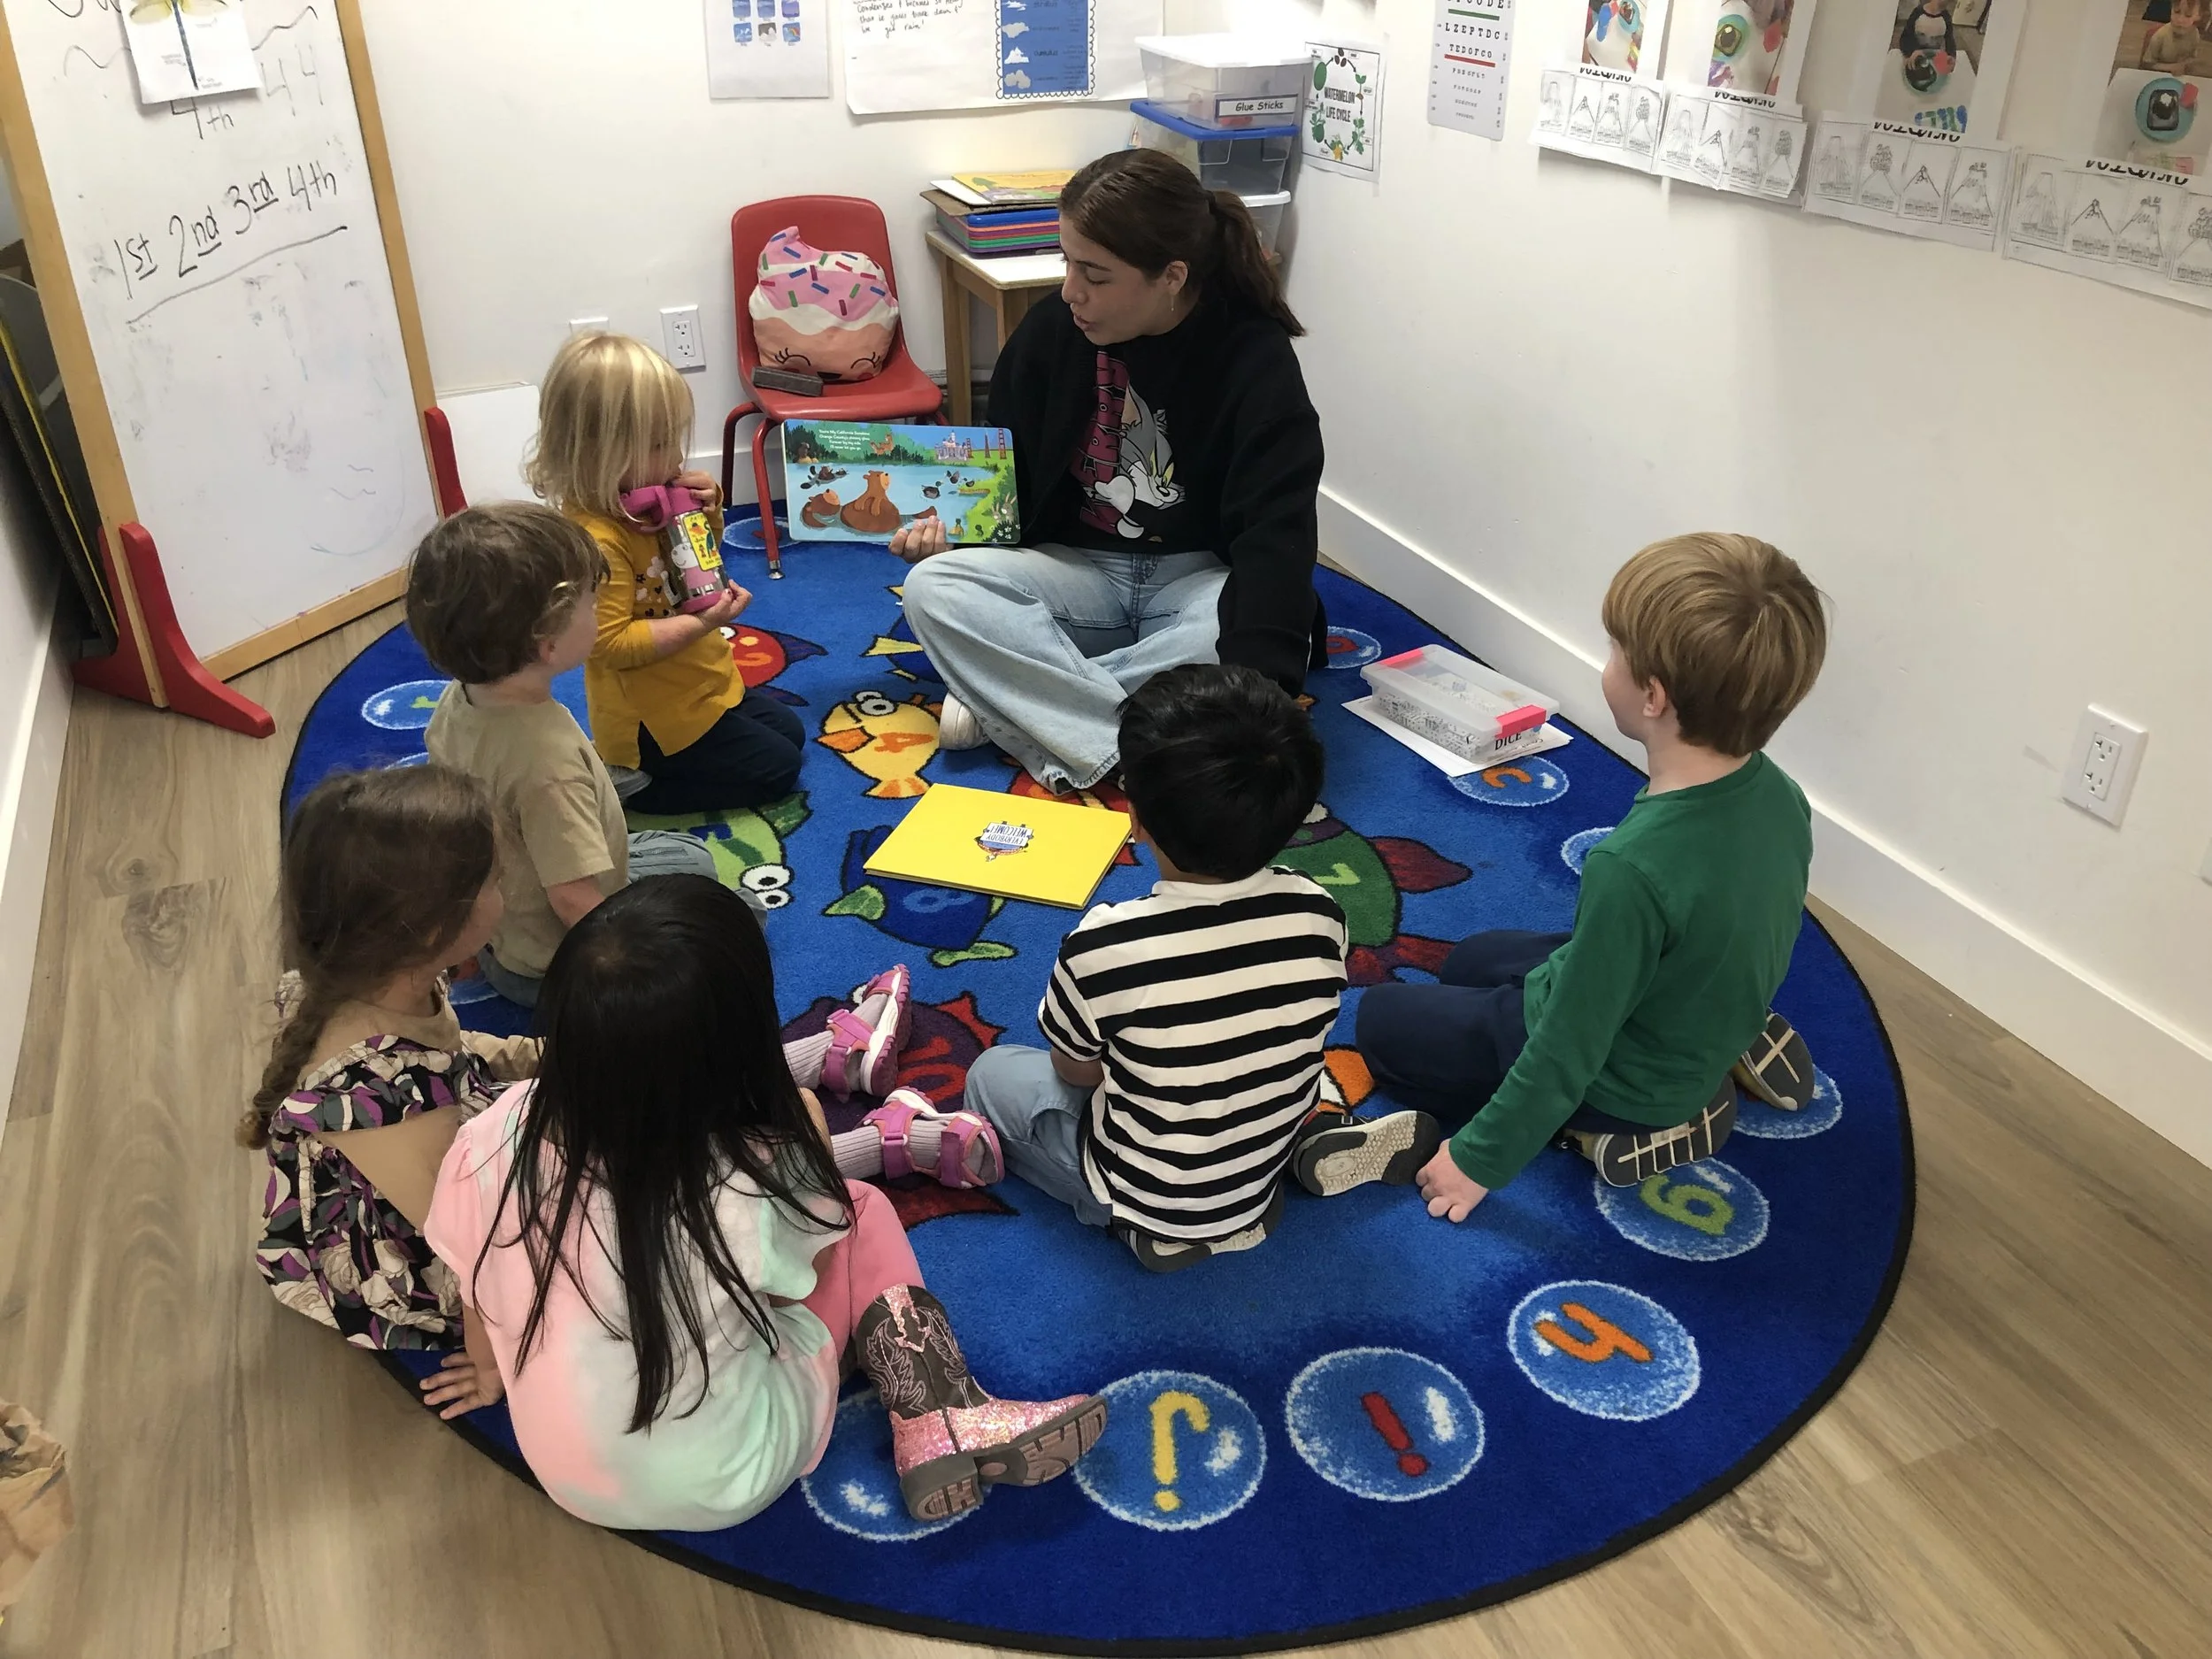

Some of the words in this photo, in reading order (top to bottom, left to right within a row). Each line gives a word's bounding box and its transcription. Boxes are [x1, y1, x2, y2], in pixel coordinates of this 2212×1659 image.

[1324, 87, 1356, 104] WATERMELON
[1235, 102, 1255, 111] Glue
[1257, 100, 1284, 111] Sticks
[1325, 106, 1336, 119] LIFE
[1336, 107, 1352, 123] CYCLE
[113, 233, 158, 300] 1st
[169, 204, 222, 278] 2nd
[227, 171, 279, 235] 3rd
[287, 160, 337, 211] 4th
[1494, 732, 1522, 751] DICE
[986, 833, 1024, 845] EVERYBODY
[989, 825, 1028, 838] WELCOME!
